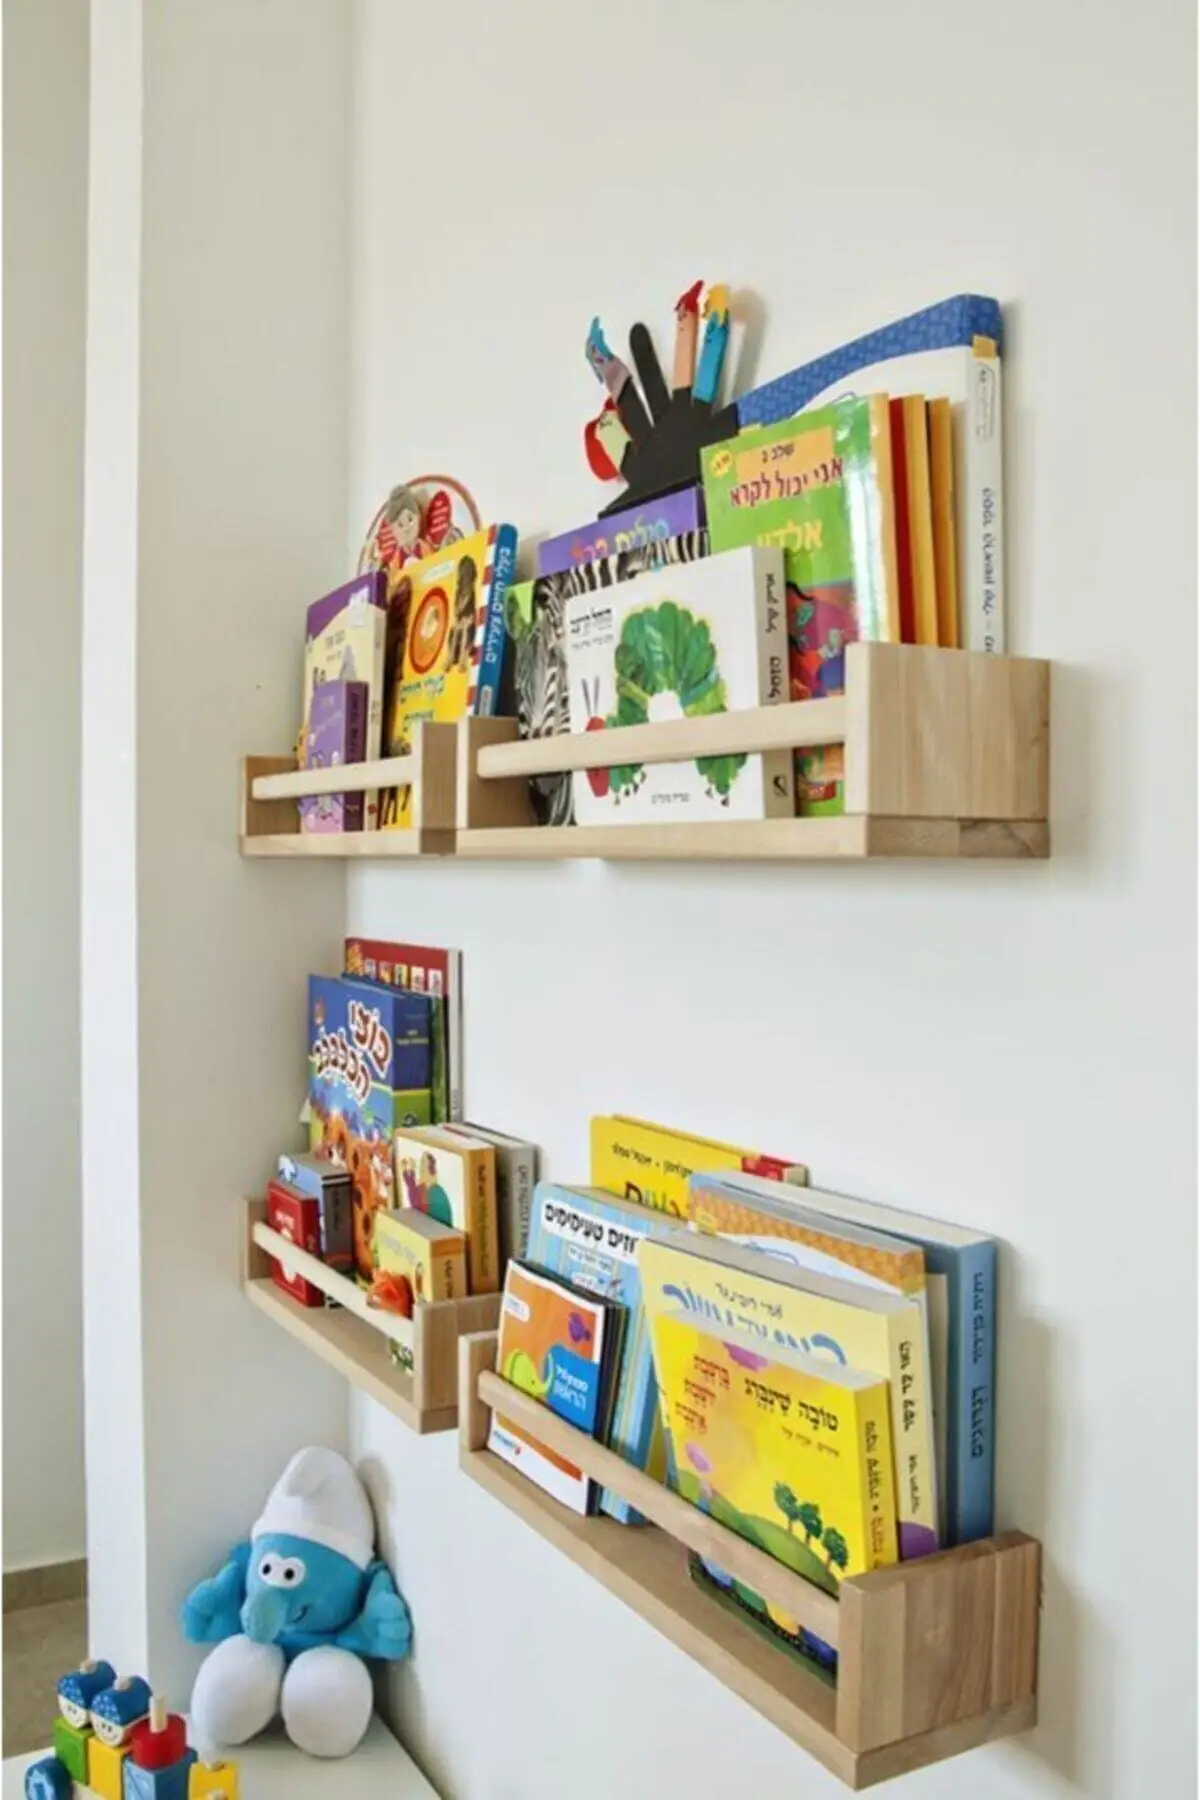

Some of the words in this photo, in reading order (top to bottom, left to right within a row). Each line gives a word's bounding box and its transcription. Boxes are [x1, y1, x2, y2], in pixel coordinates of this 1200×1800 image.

[775, 469, 809, 498] יכול
[813, 456, 843, 484] אני
[729, 471, 772, 508] לקרא
[982, 486, 998, 527] הספר
[982, 532, 998, 584] הראשון
[492, 580, 507, 613] חיים
[983, 589, 998, 616] שלי
[768, 656, 781, 700] הזחל
